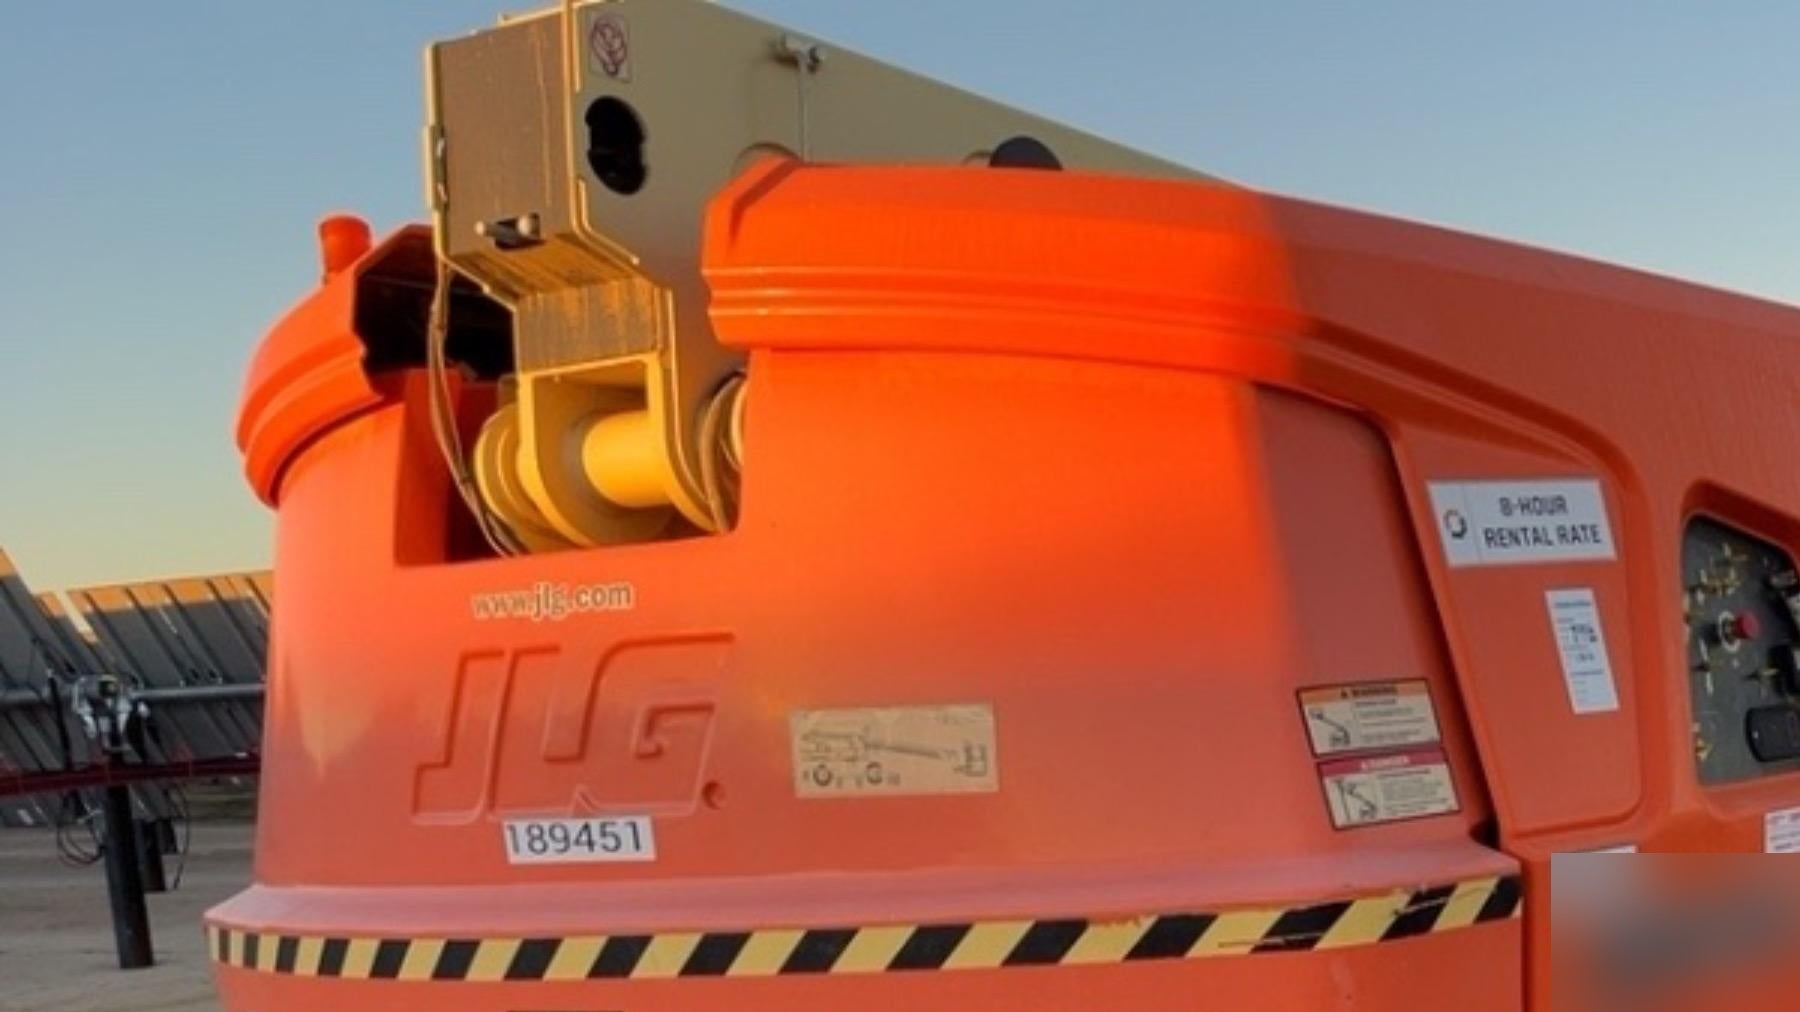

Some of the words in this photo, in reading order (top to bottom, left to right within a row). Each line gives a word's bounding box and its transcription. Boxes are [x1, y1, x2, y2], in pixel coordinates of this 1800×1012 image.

[1498, 495, 1569, 517] 8-HOUR
[1483, 525, 1554, 549] RENTAL
[1556, 523, 1602, 545] RATE
[473, 580, 634, 622] www.jlg.com
[506, 820, 644, 856] 189451
